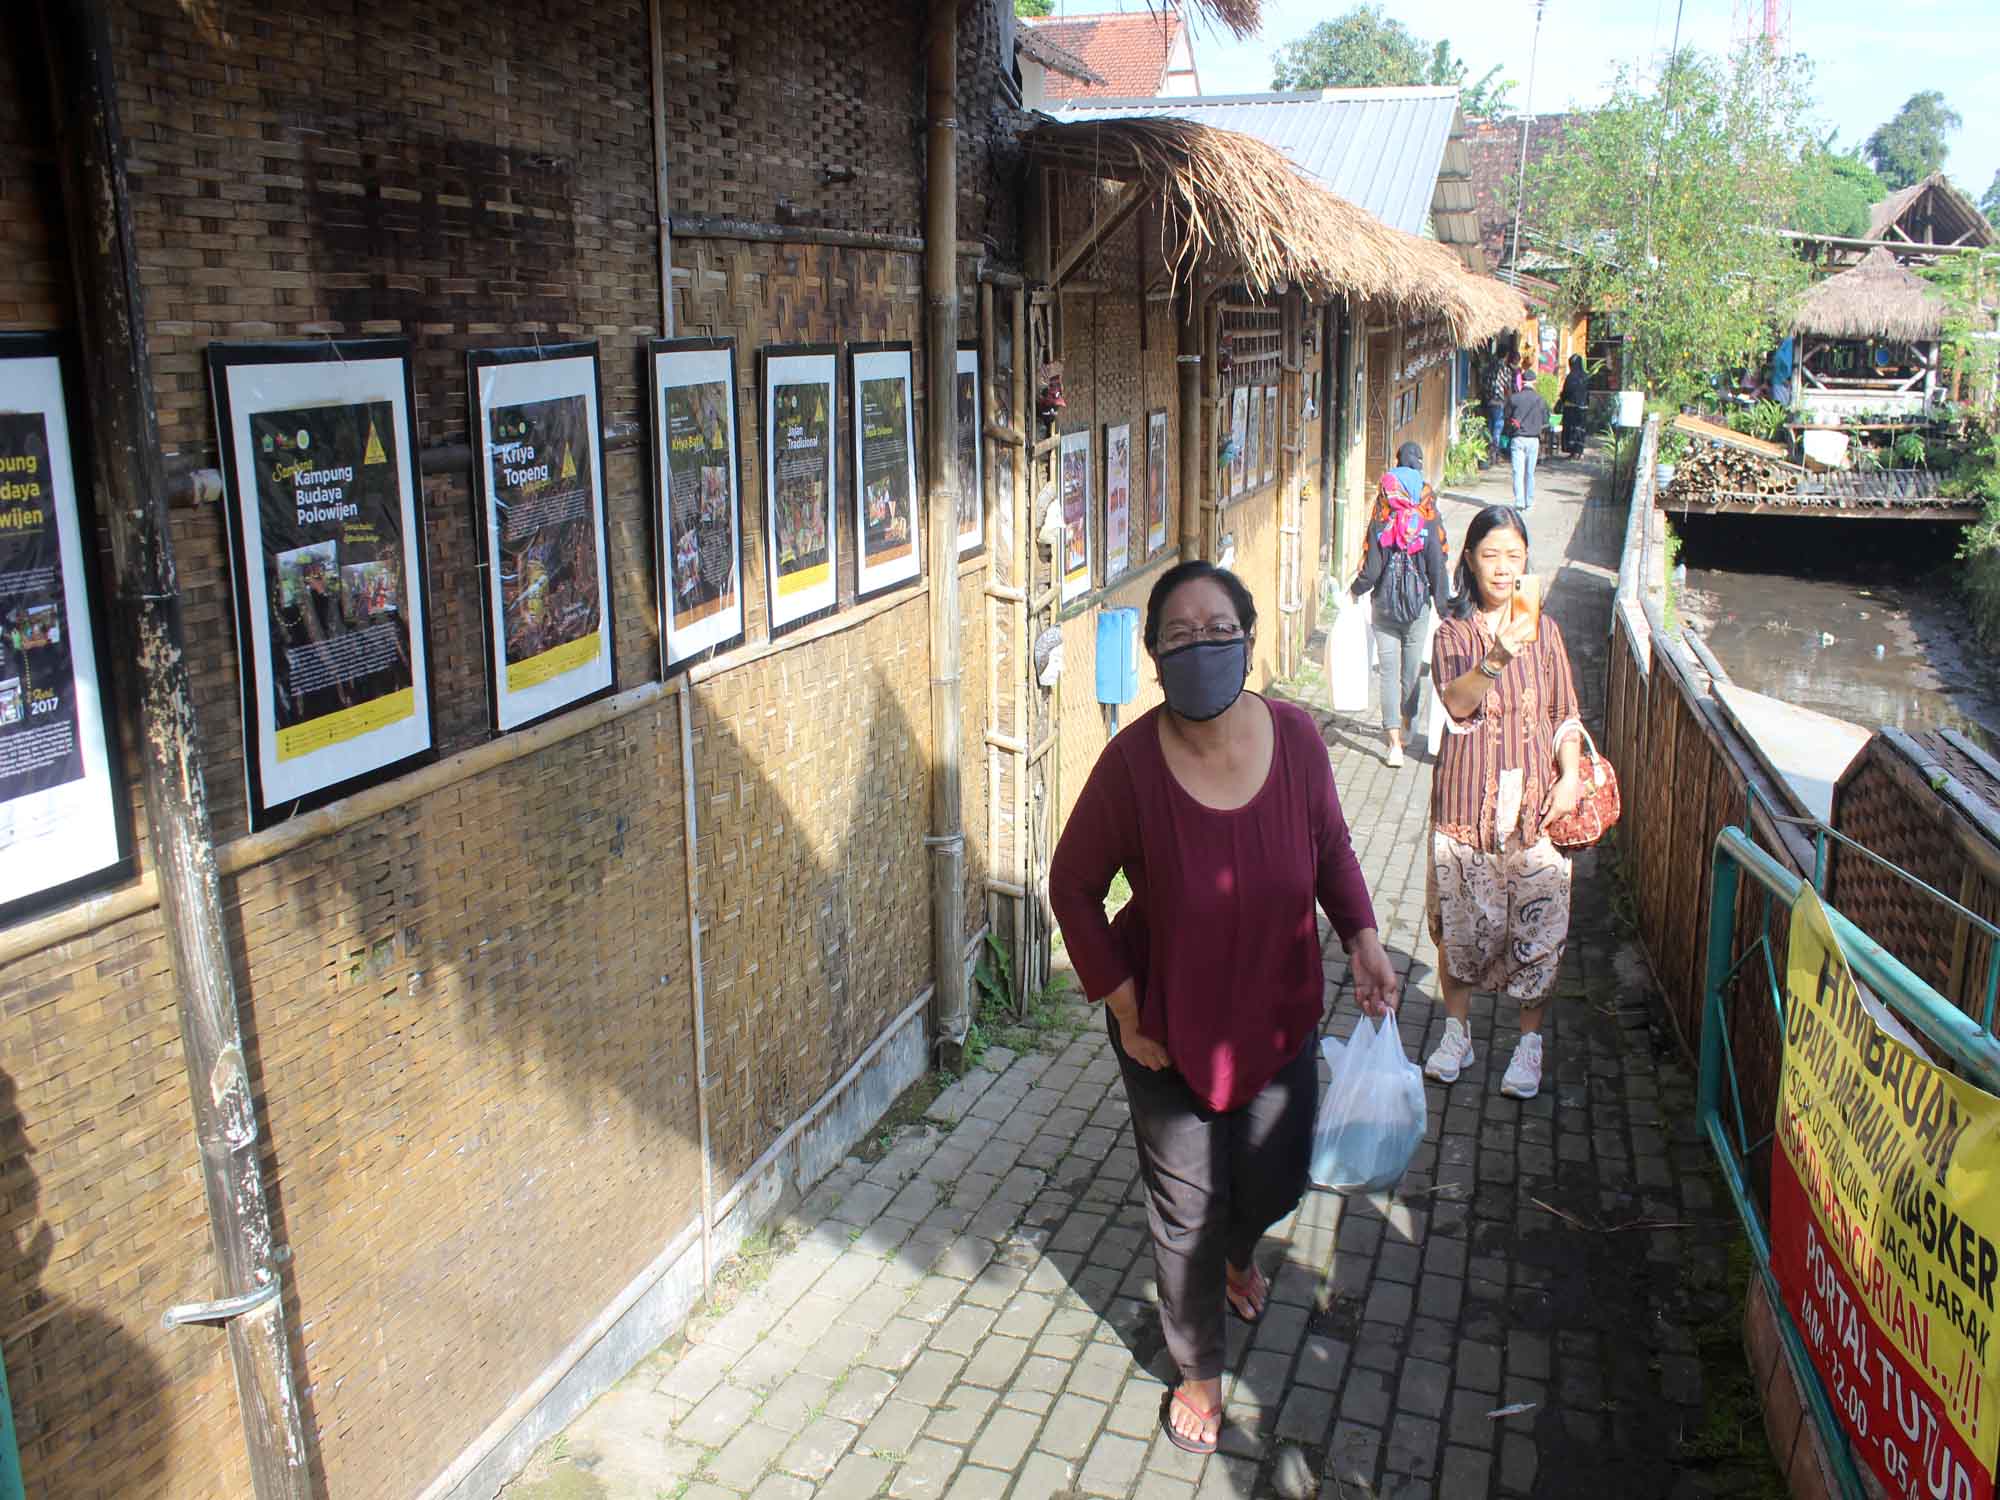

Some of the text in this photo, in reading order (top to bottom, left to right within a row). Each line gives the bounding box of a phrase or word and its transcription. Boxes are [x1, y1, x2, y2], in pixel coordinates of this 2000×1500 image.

[502, 445, 535, 464] Kriya
[294, 465, 353, 486] Kampung
[503, 464, 548, 487] Topeng
[0, 481, 40, 501] daya
[296, 486, 342, 506] Budaya
[297, 502, 358, 525] Polowijen
[32, 697, 59, 715] 2017
[1816, 947, 1972, 1189] HIMBAUAN
[1785, 988, 1999, 1313] UPAYA MEMAKAI MASKER
[1811, 1106, 1869, 1222] DISTANCING
[1879, 1217, 1920, 1293] JAGA
[1926, 1270, 1992, 1369] JARAK
[1807, 1223, 1872, 1387] PORTAL
